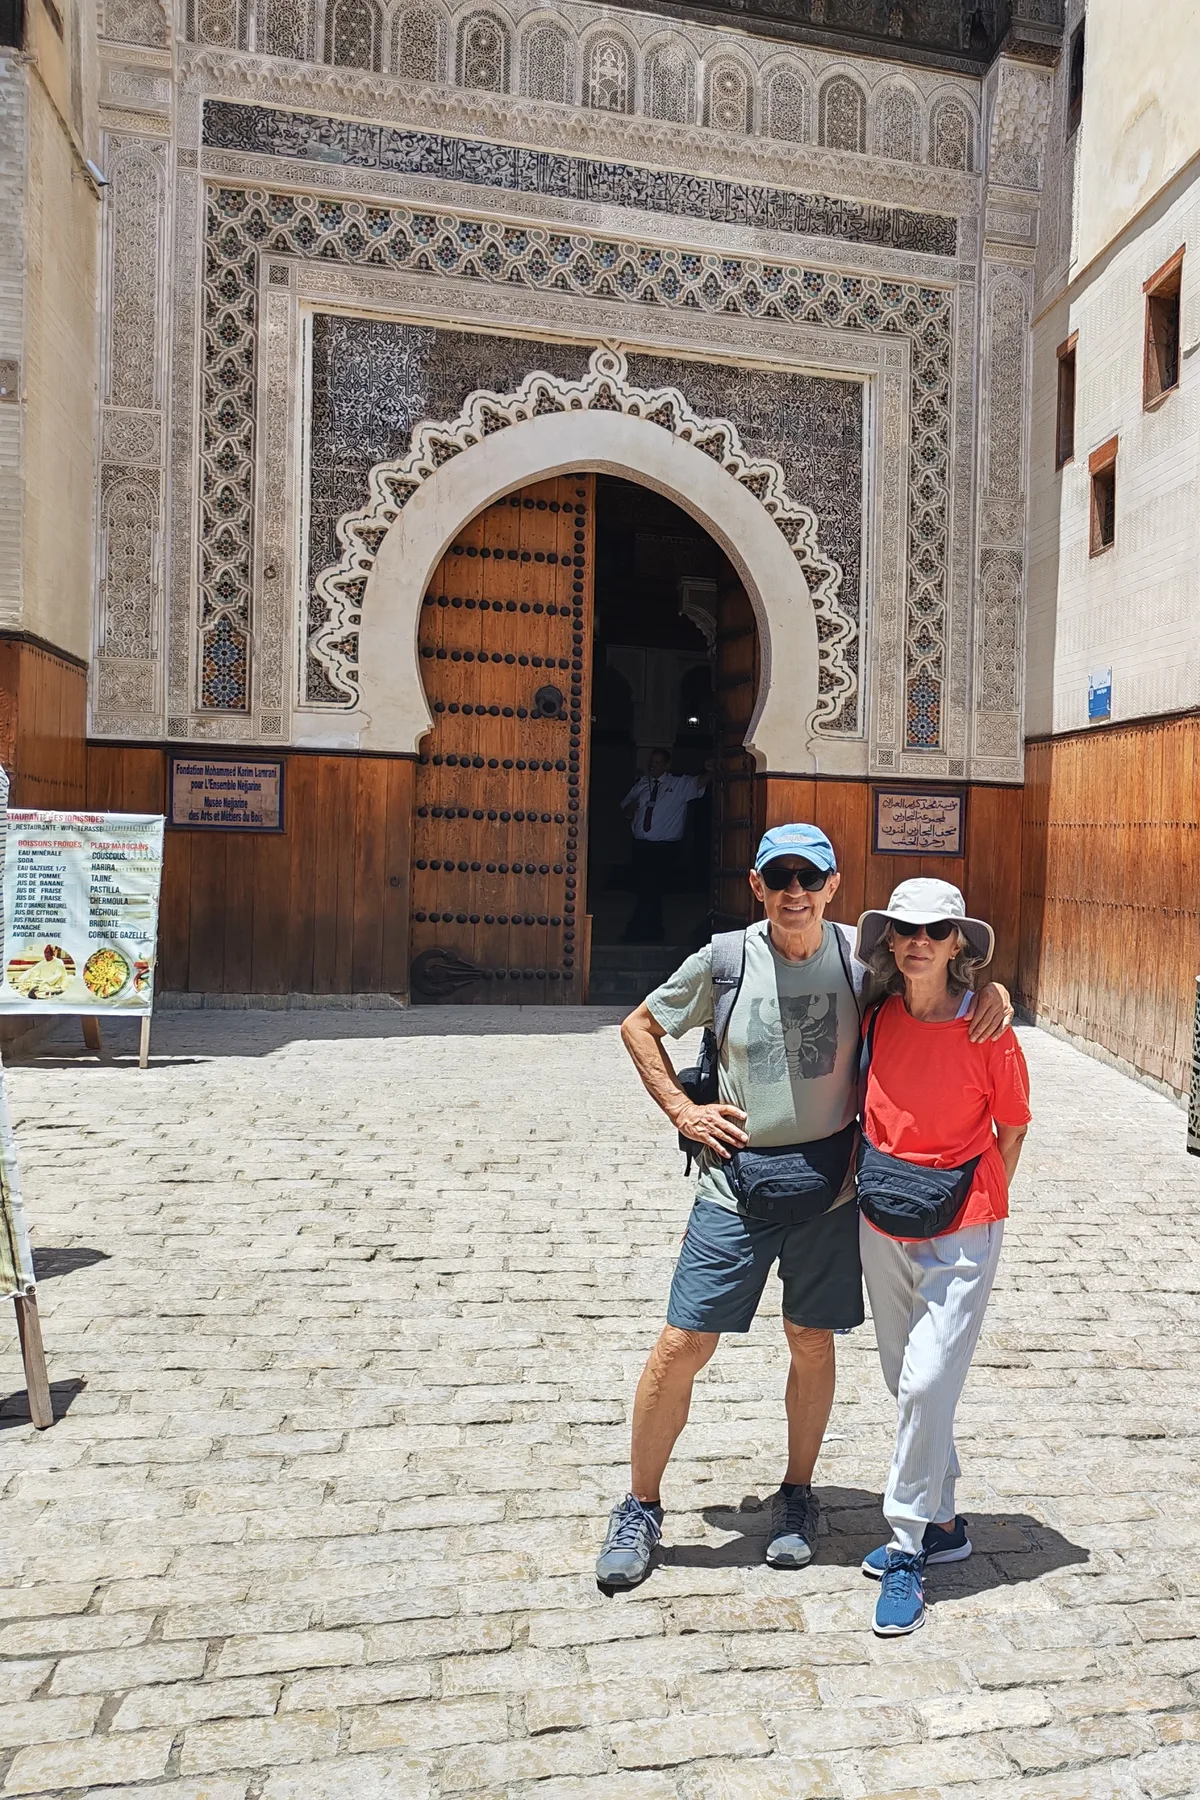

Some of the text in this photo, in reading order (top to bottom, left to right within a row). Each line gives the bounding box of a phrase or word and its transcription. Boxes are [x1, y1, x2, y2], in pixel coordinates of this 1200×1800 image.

[176, 764, 277, 779] Fondation Mohammed Karim Lamrani
[190, 780, 204, 791] pour
[237, 781, 262, 794] Nejjarine
[204, 796, 249, 812] Musée Nejjarine
[905, 799, 927, 810] كريم
[920, 800, 938, 810] محمد
[936, 800, 958, 811] مؤسسة
[188, 810, 264, 823] des Arts et Métiers du Bois
[892, 810, 946, 825] لمجموعة النجارين
[881, 823, 957, 837] متحف النجارين لفنون
[18, 840, 82, 848] BOISSONS FROIDES
[891, 836, 946, 848] وحرف الخشب
[31, 849, 62, 857] MINÉRALE
[38, 872, 61, 880] POMME
[45, 917, 67, 925] ORANGE
[12, 923, 42, 931] PANACHÉ
[37, 931, 62, 939] ORANGE
[88, 931, 110, 939] CORNE
[110, 931, 119, 939] DE
